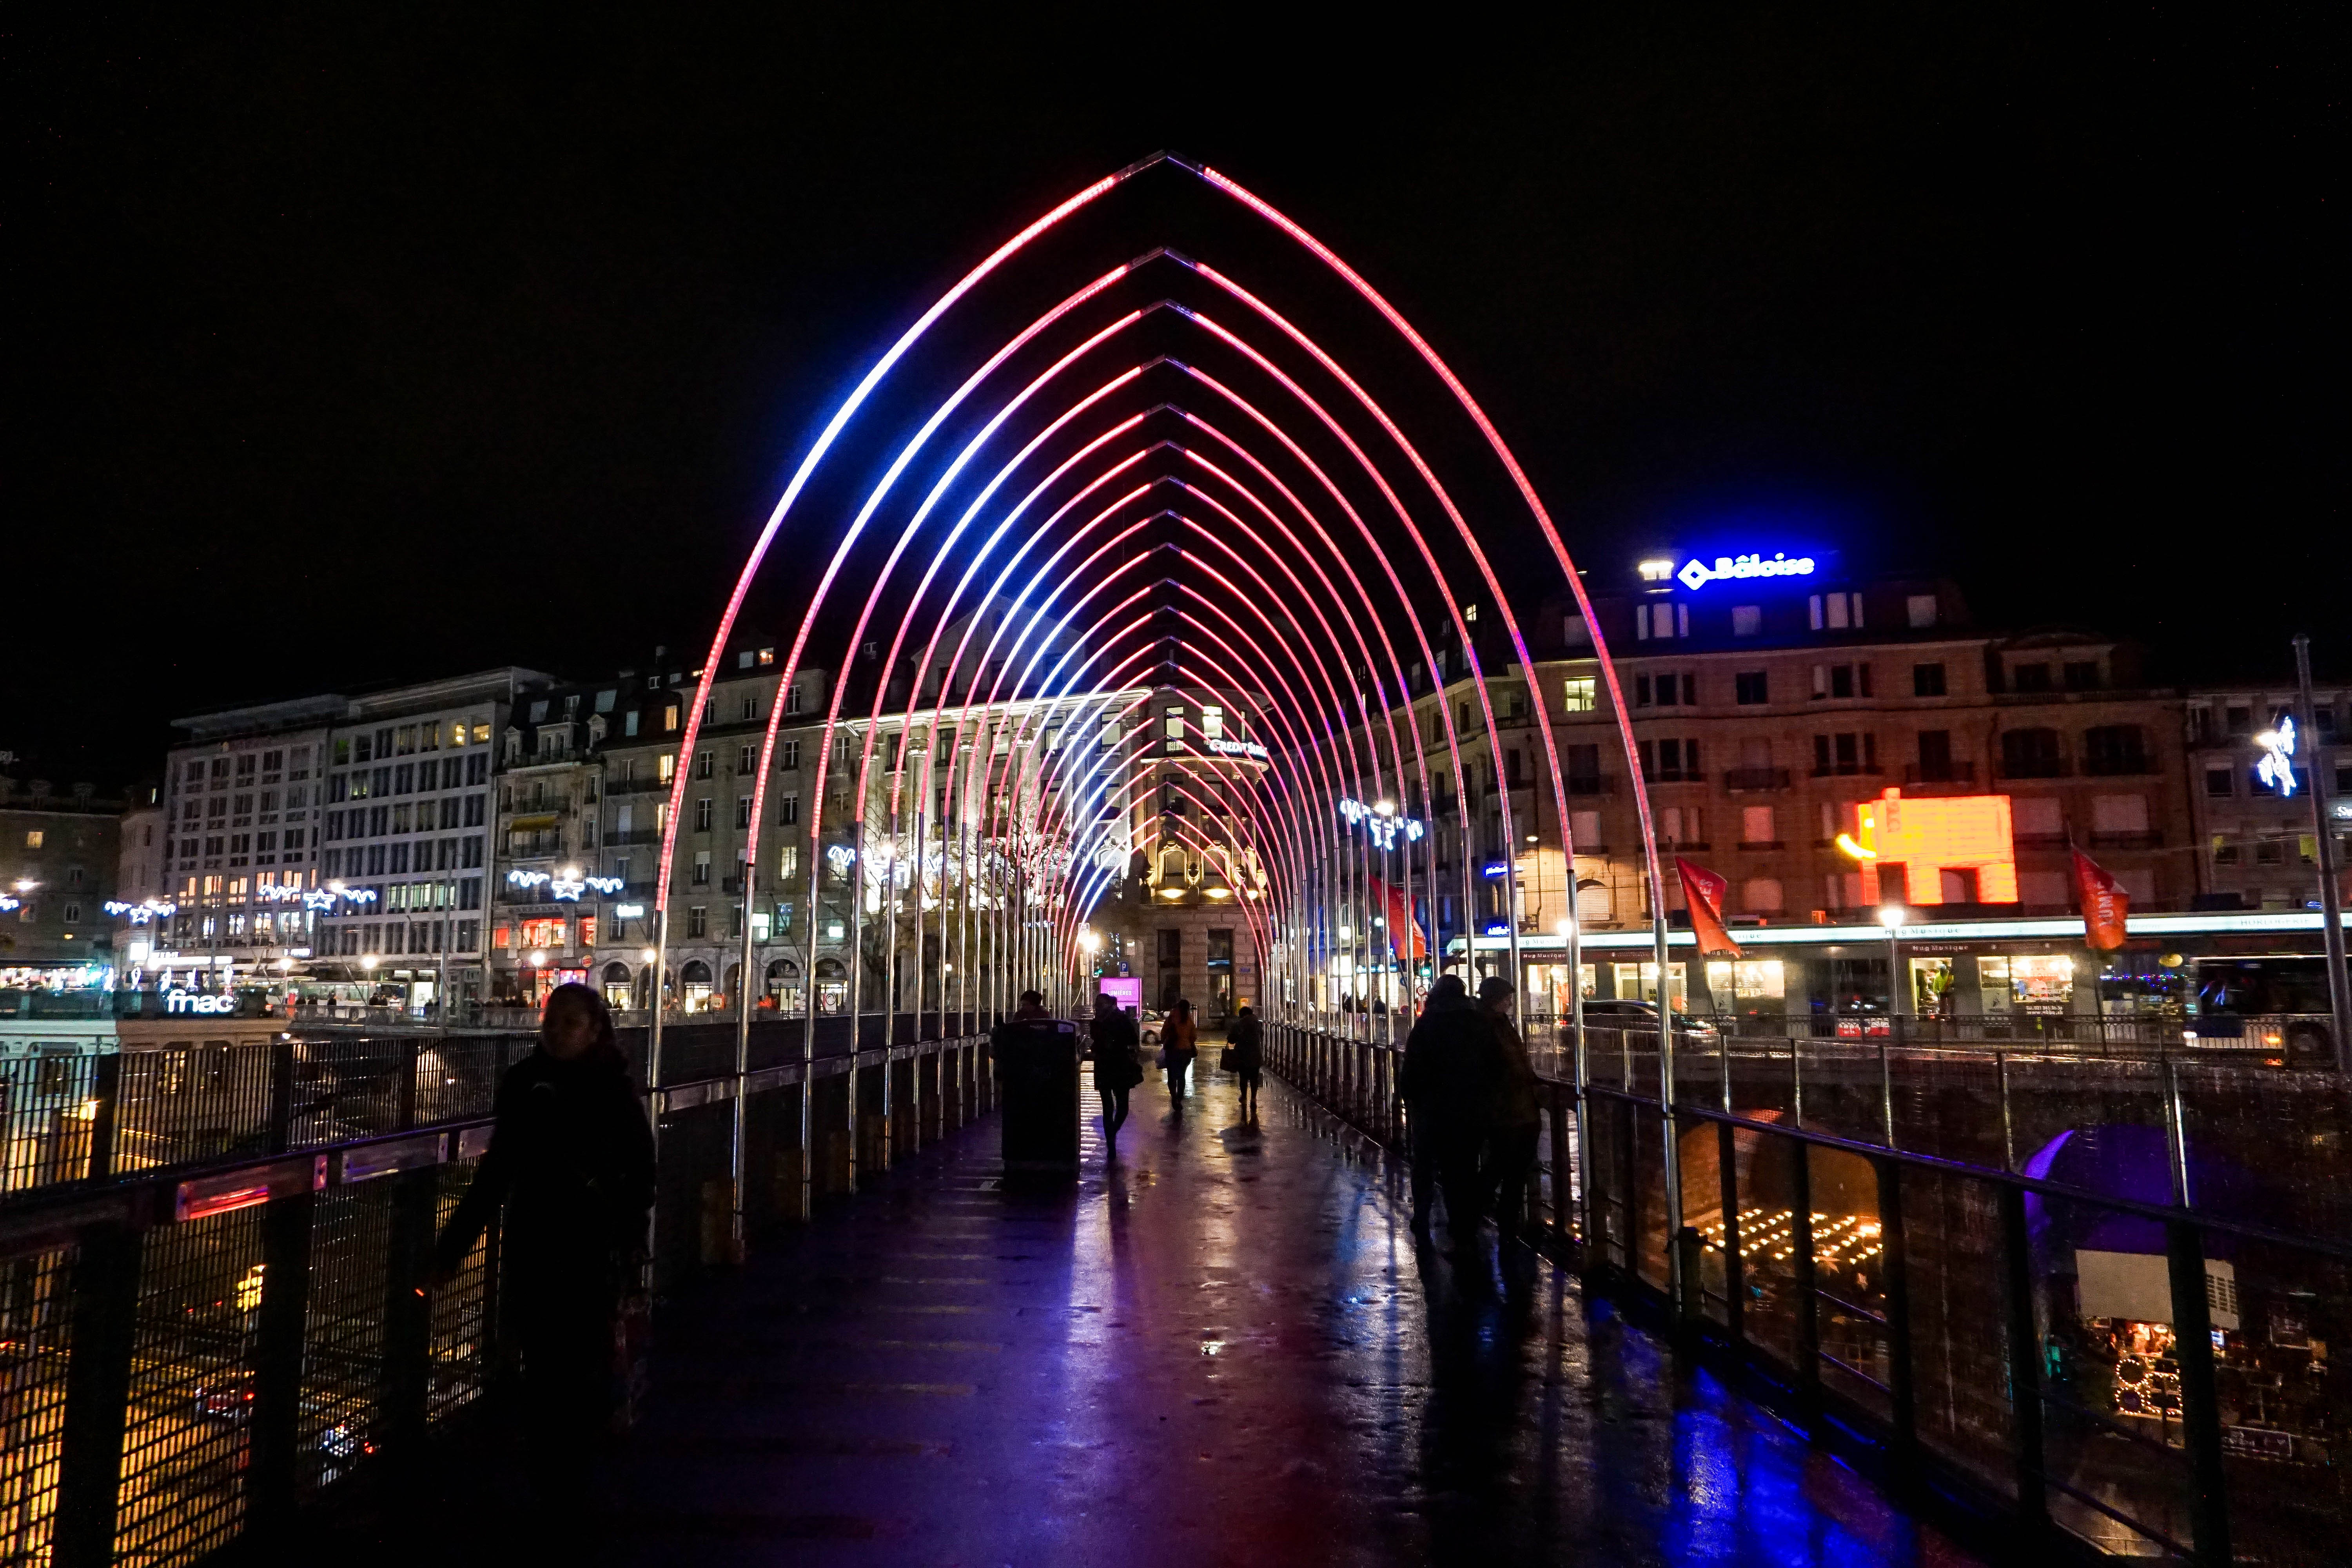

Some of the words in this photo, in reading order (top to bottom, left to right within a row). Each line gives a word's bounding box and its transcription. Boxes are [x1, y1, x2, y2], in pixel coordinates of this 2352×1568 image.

[1715, 552, 1815, 579] Bâloise
[1910, 927, 1960, 936] Musique
[167, 989, 234, 1013] fnac
